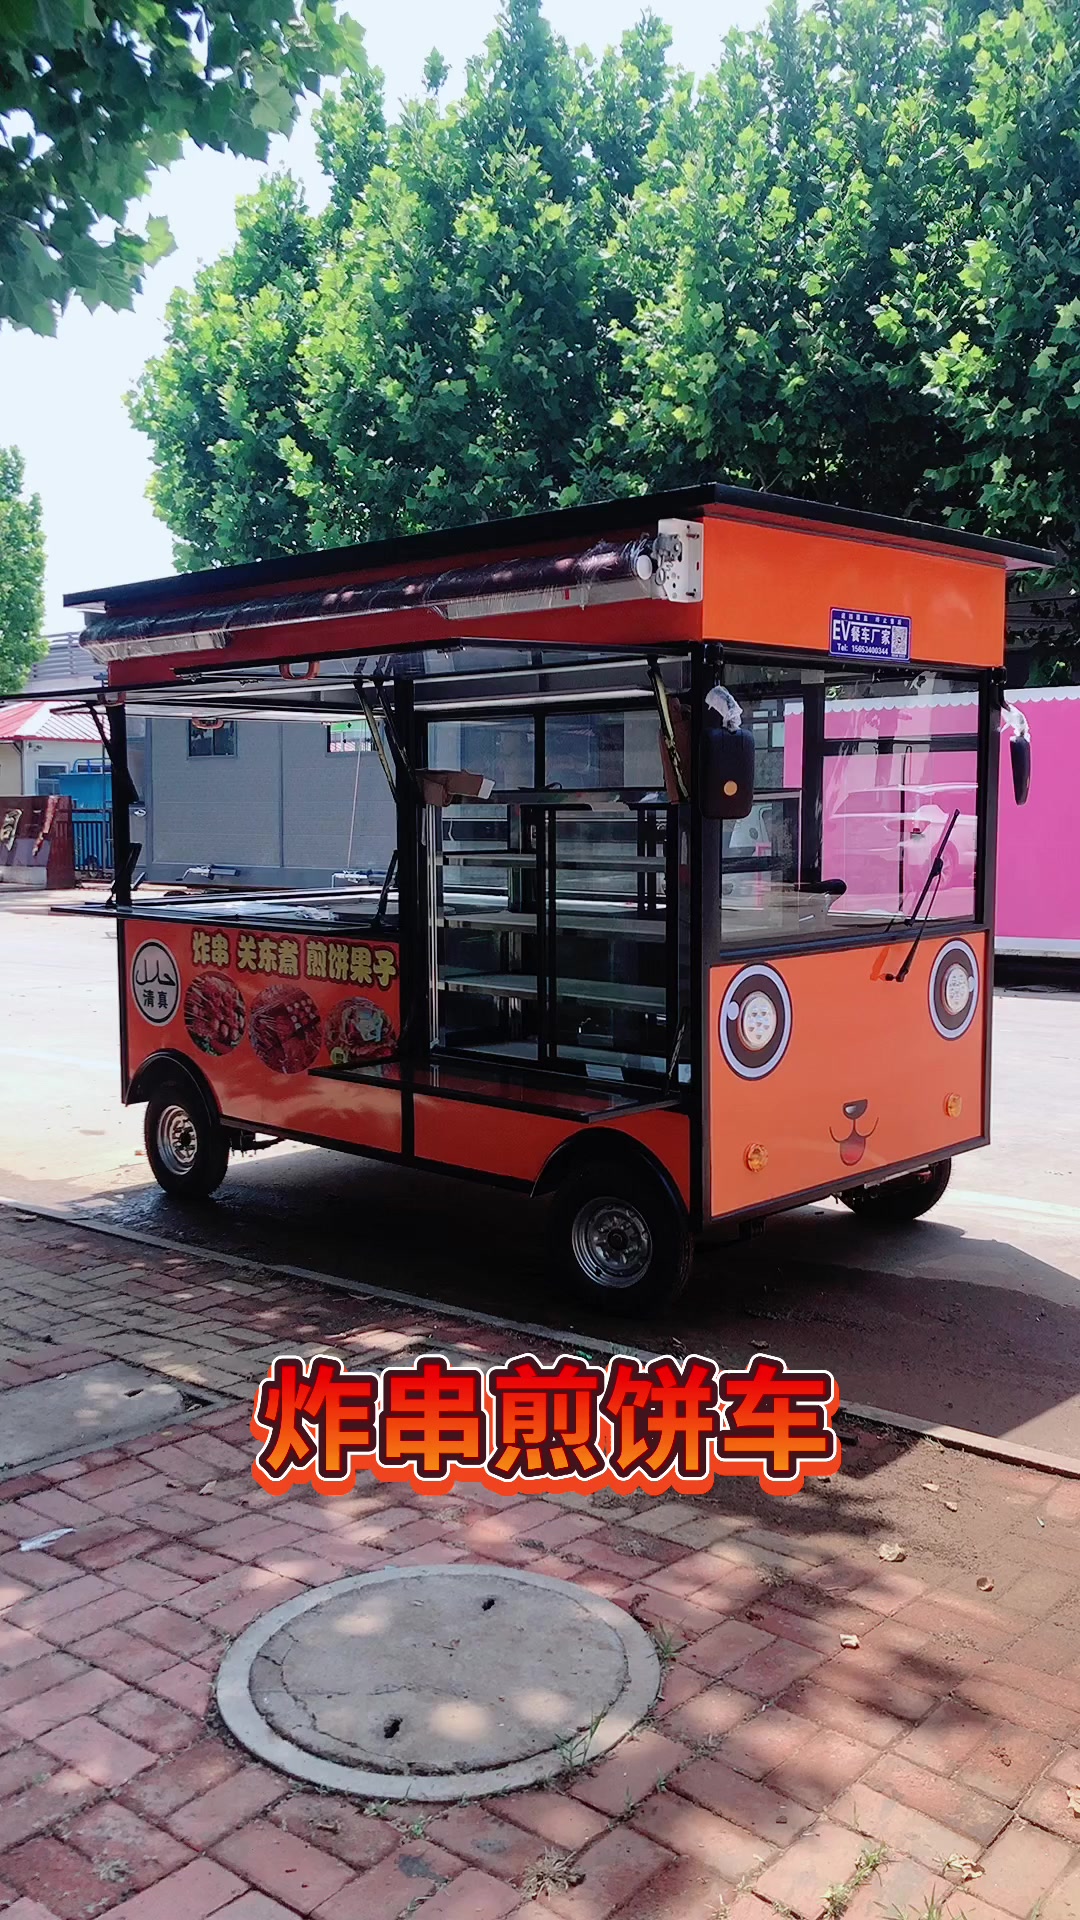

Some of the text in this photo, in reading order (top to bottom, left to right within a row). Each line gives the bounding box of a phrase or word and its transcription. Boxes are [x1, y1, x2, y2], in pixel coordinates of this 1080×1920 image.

[832, 619, 891, 645] EV餐车厂家
[192, 932, 396, 987] 炸串 关东煮 煎饼果子
[143, 990, 168, 1009] 清真
